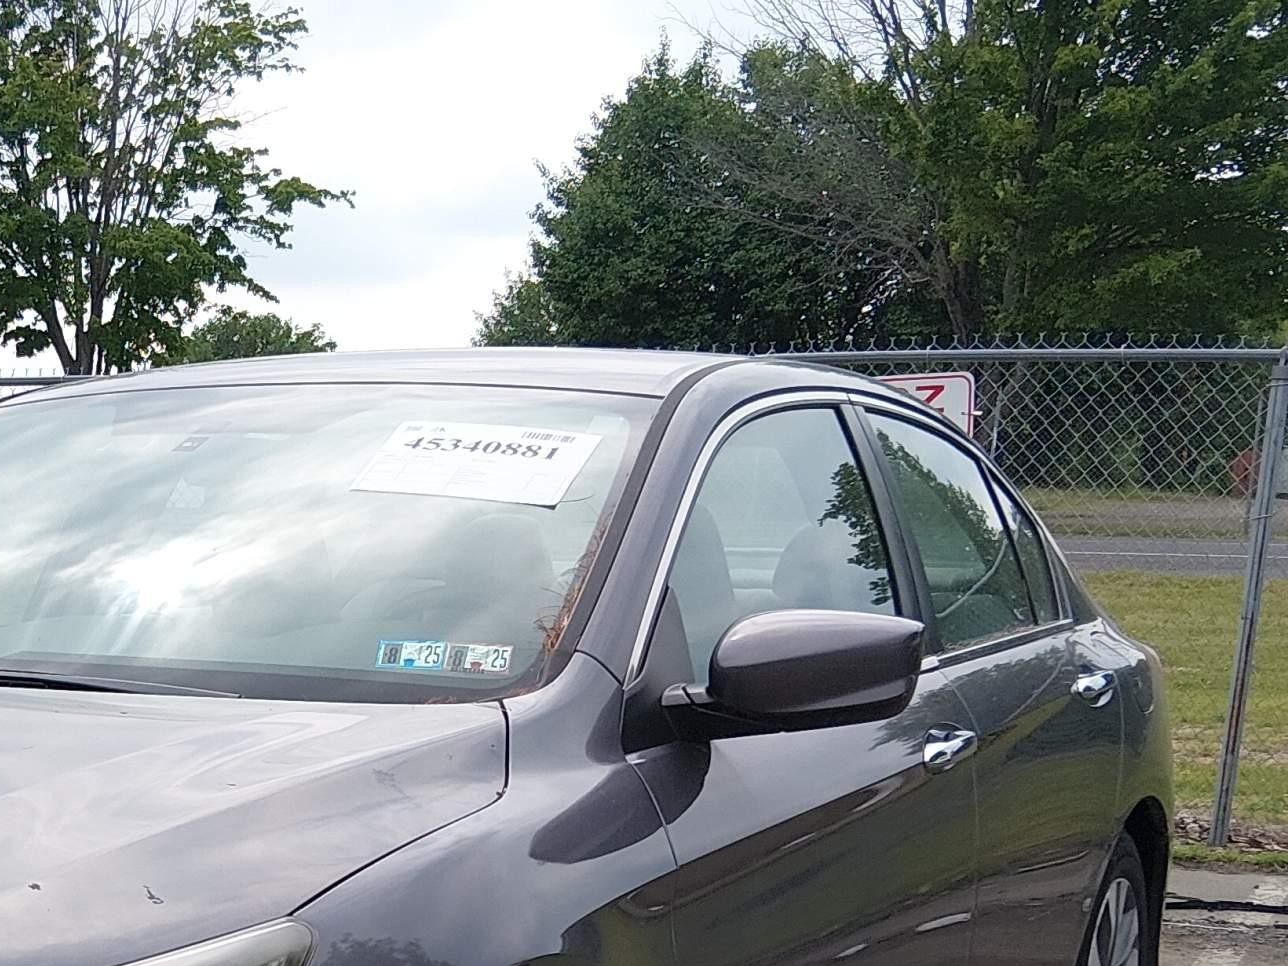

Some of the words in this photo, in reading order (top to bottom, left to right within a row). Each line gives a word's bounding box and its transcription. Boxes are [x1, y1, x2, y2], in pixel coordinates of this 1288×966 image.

[403, 436, 560, 460] 45340881
[424, 645, 441, 665] 25
[491, 648, 509, 669] 25
